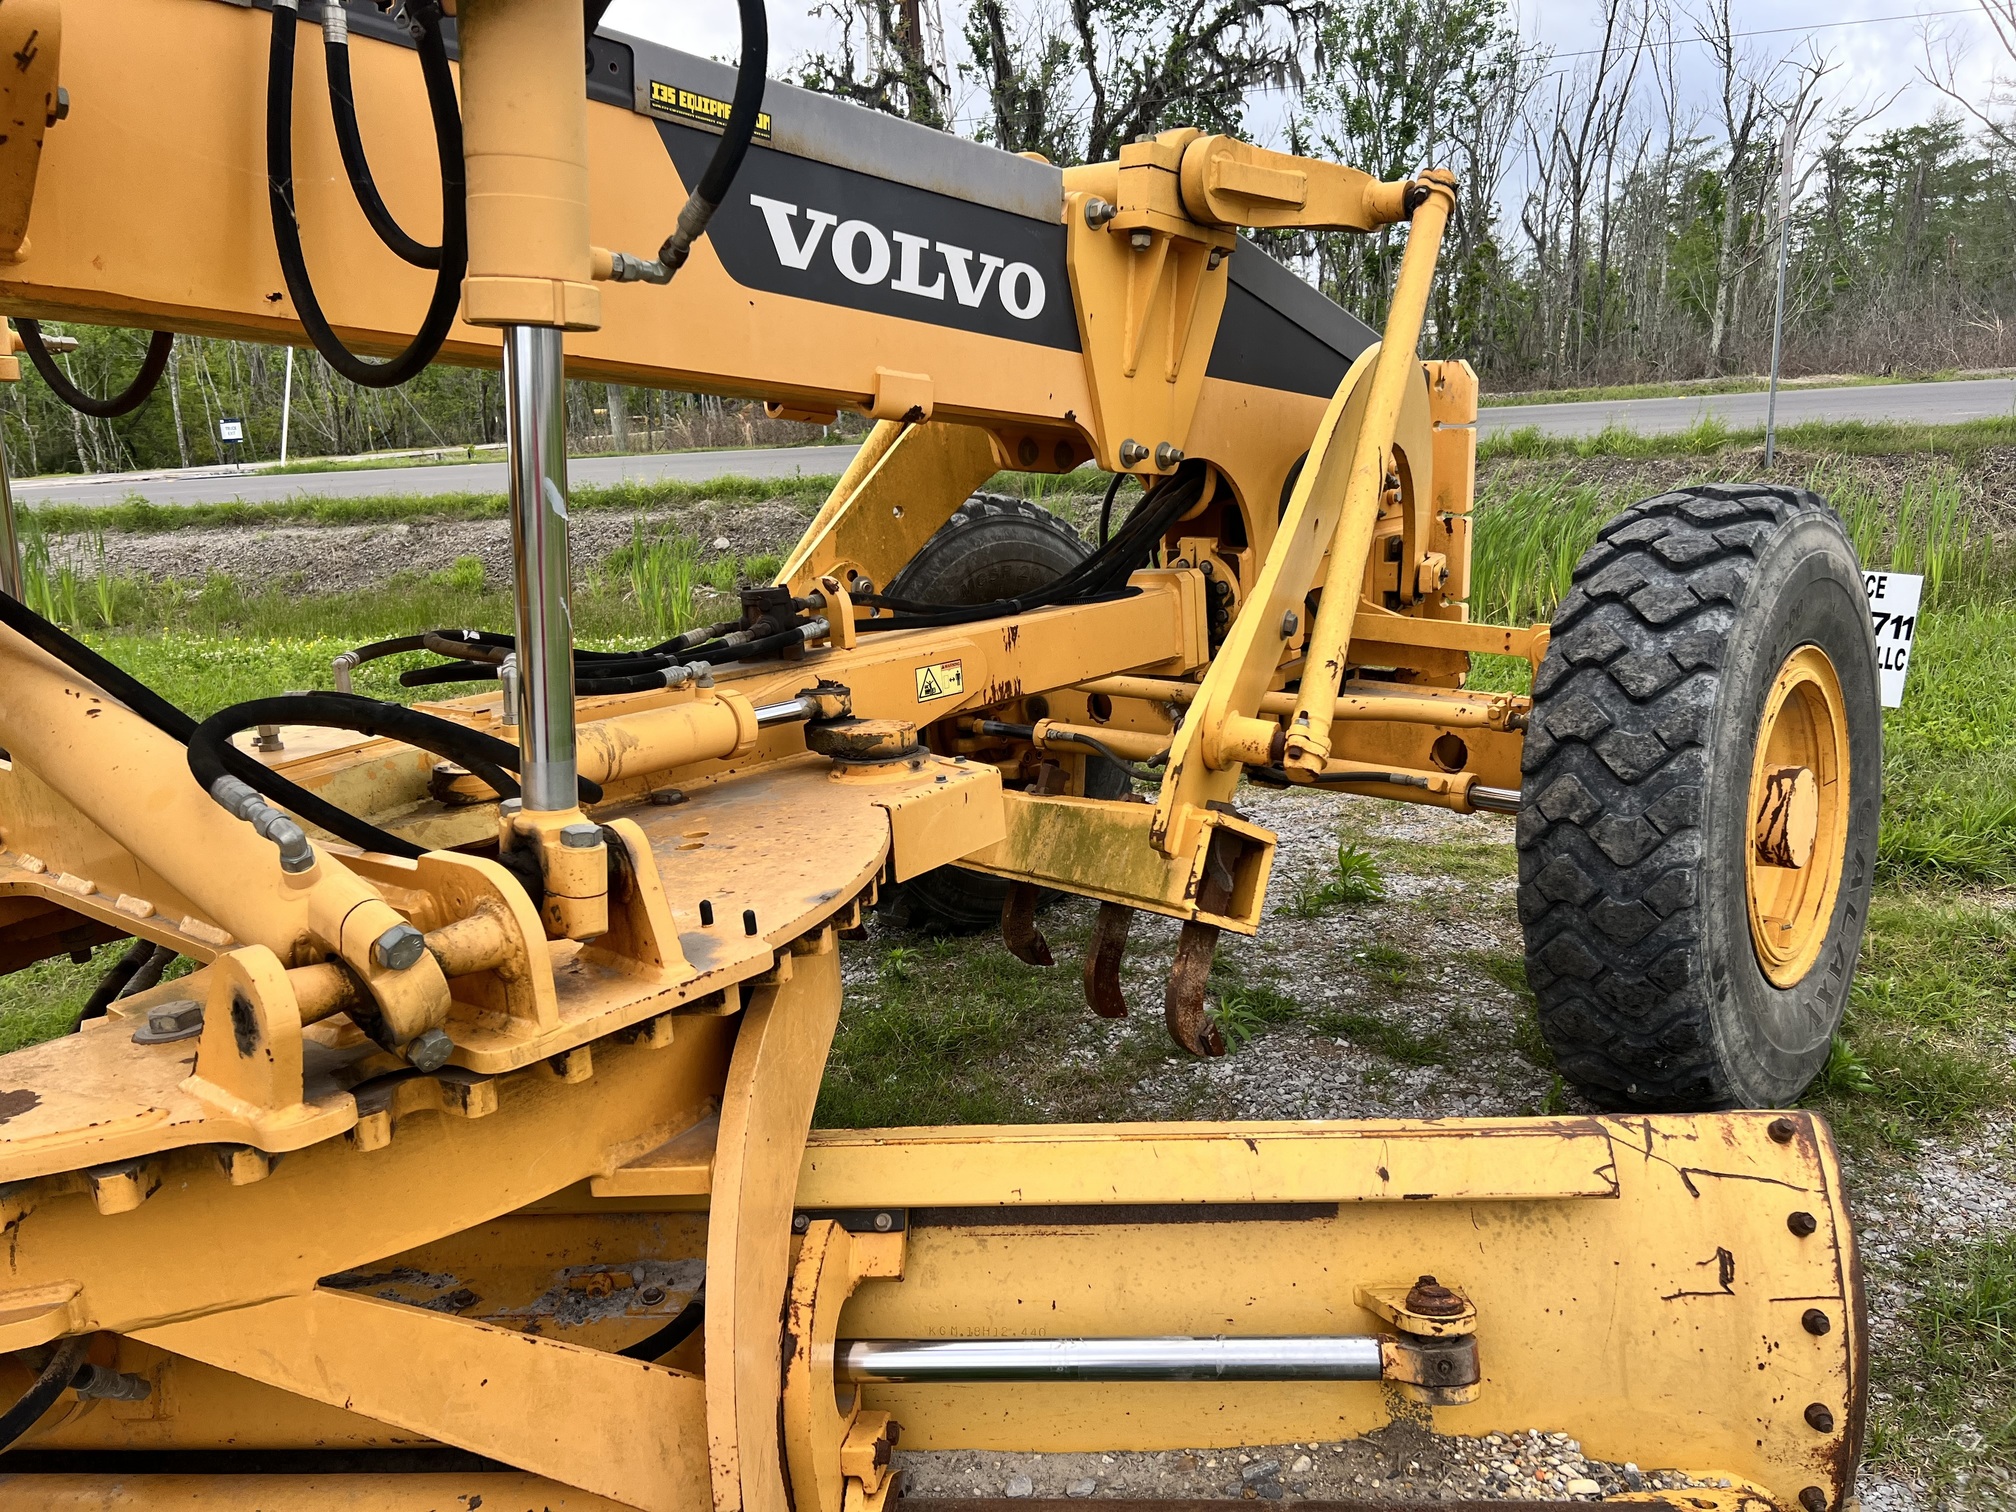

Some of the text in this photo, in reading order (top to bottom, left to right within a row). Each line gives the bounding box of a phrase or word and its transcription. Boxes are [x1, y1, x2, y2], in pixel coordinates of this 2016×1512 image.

[750, 194, 1046, 320] VOLVO
[1862, 575, 1888, 599] CE
[1803, 797, 1873, 1033] GALAXY
